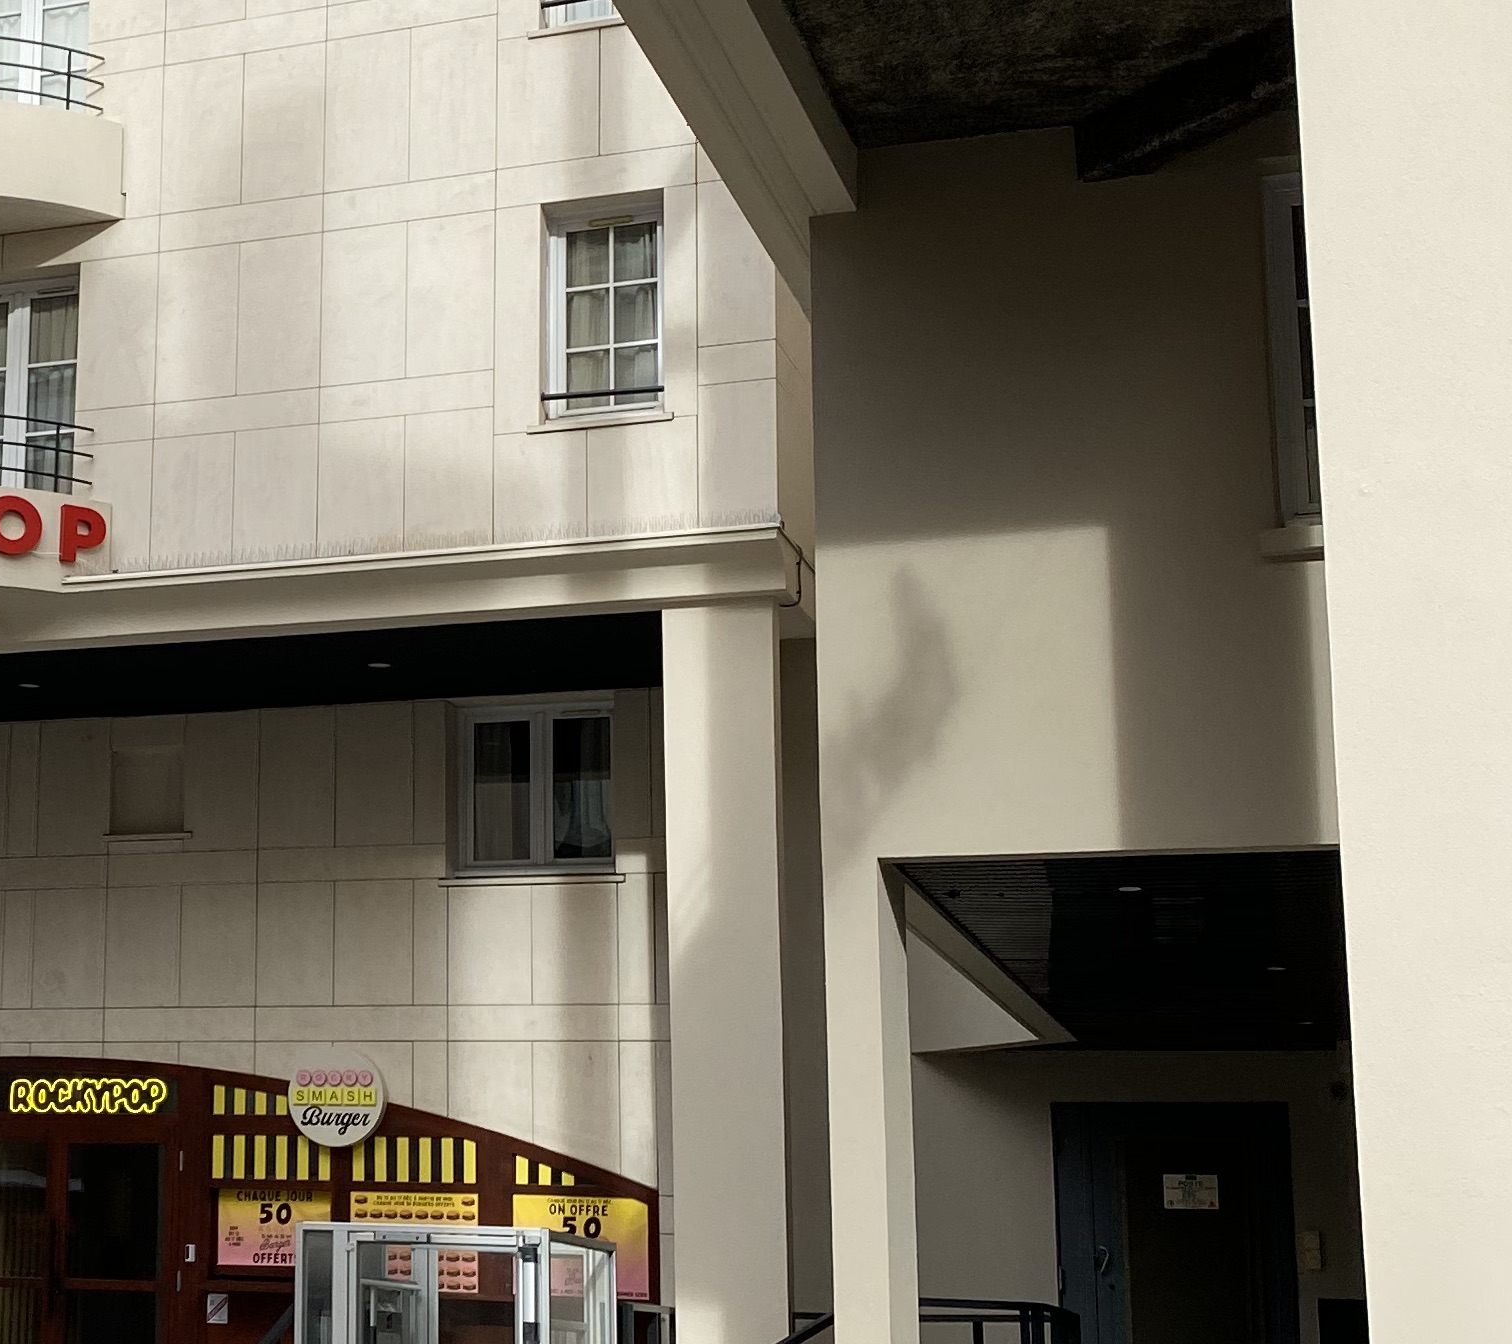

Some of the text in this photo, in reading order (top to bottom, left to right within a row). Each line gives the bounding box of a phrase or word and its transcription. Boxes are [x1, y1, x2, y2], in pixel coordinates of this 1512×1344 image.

[10, 1078, 167, 1113] ROCKYPOP
[296, 1090, 373, 1102] SMASH
[300, 1106, 371, 1135] Burger
[236, 1190, 313, 1202] CHAQUE JOUR
[259, 1203, 292, 1225] 50
[549, 1204, 609, 1216] ON OFFRE
[562, 1216, 601, 1239] 50
[252, 1253, 296, 1264] OFFERT
